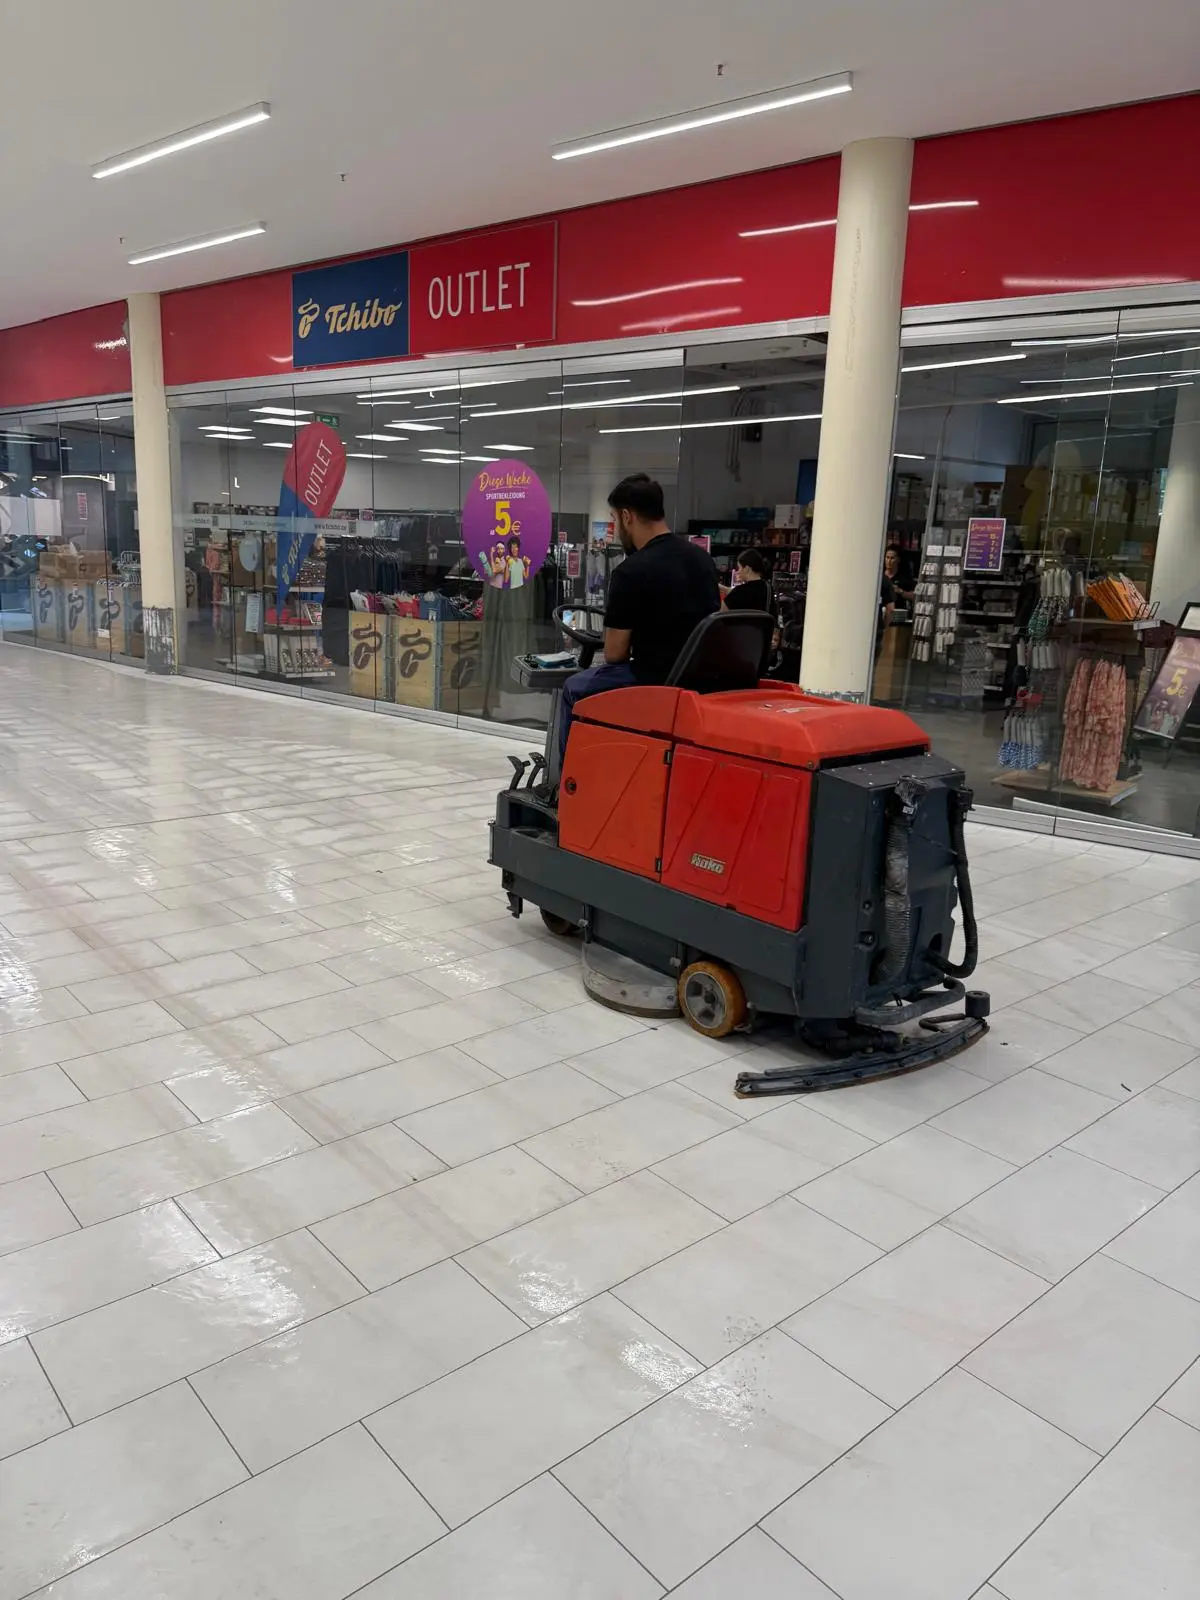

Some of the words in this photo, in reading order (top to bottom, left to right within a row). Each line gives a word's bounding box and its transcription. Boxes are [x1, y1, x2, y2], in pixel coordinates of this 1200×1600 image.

[325, 298, 402, 334] Tchibo
[428, 262, 530, 319] OUTLET
[304, 439, 333, 505] OUTLET
[506, 470, 532, 488] Woche
[485, 492, 526, 500] SPORTBEKLEIDUNG
